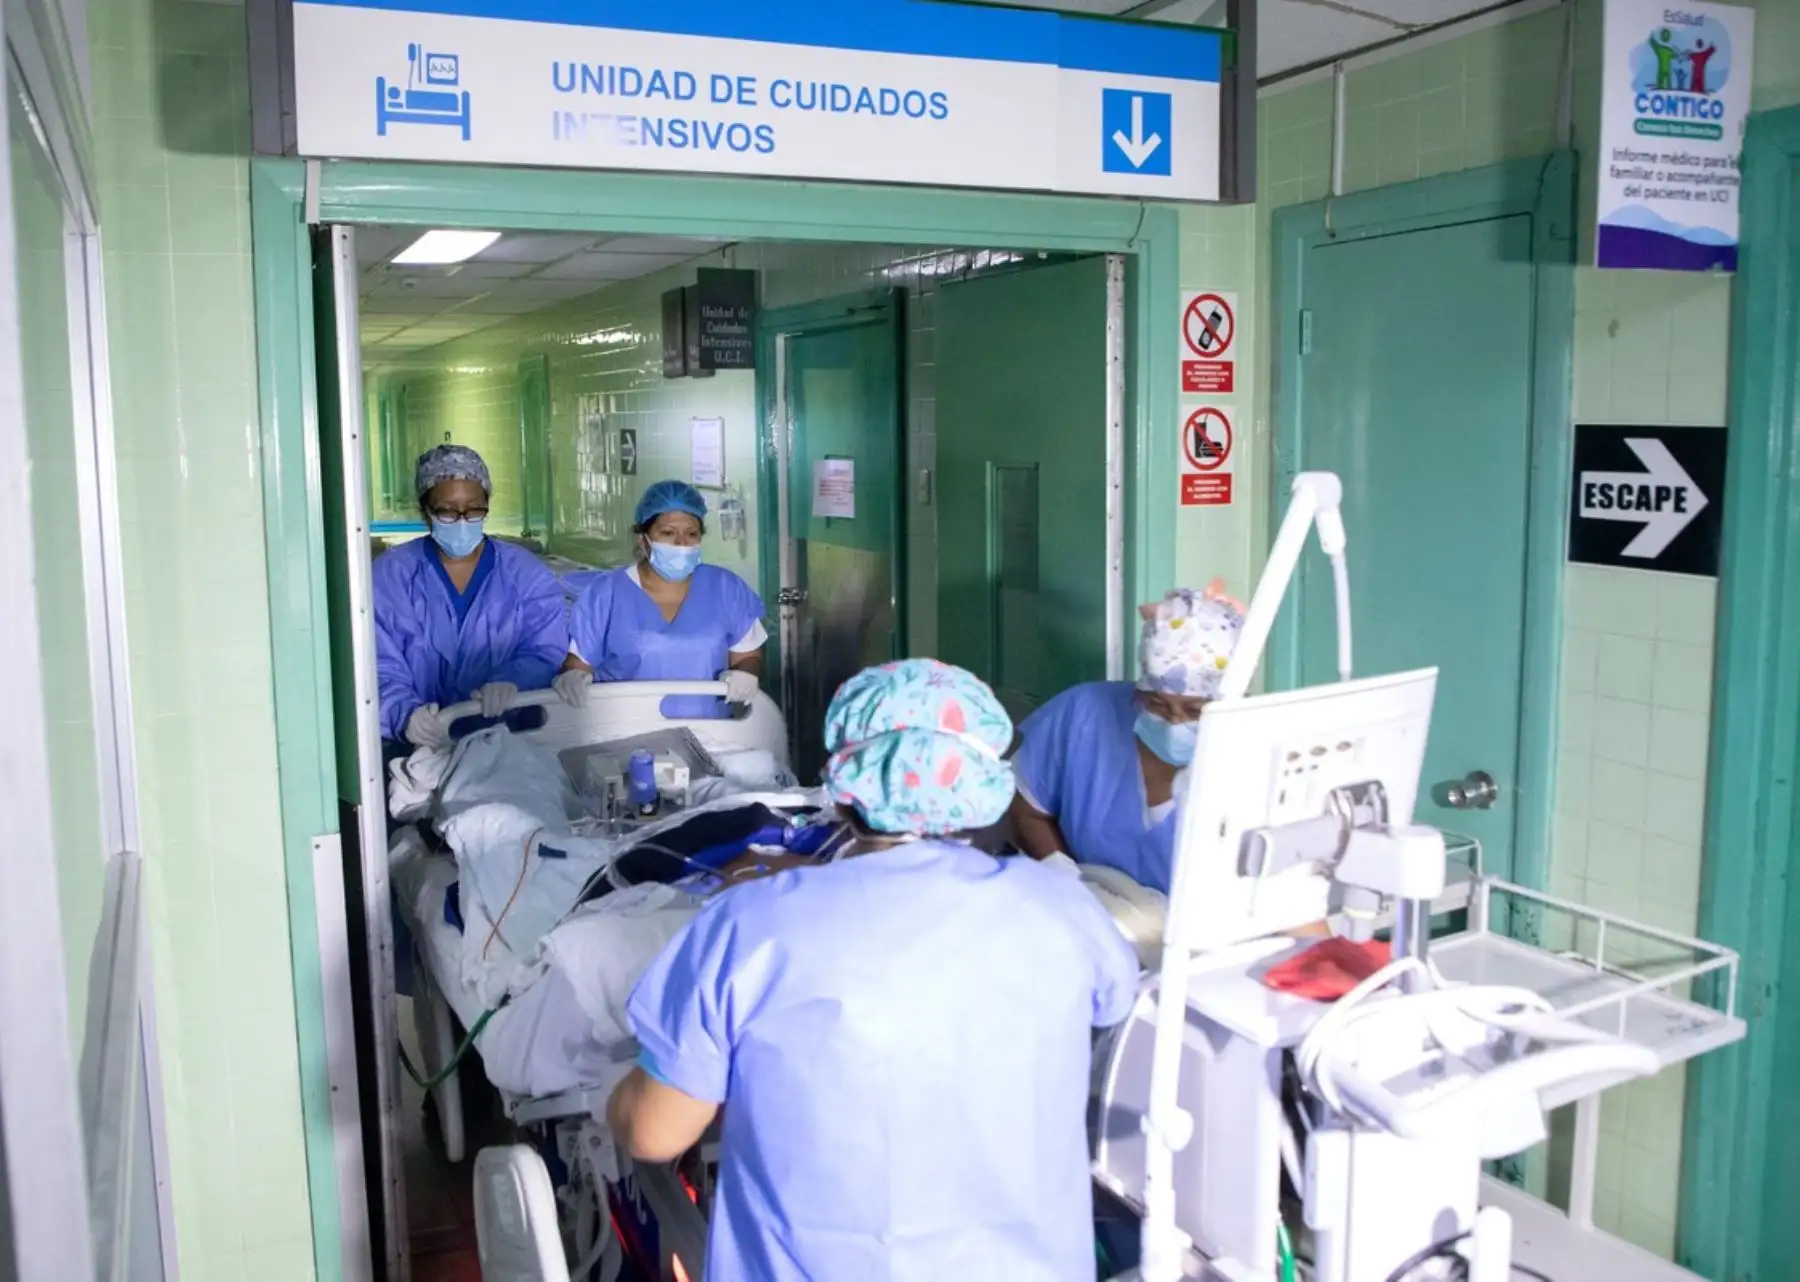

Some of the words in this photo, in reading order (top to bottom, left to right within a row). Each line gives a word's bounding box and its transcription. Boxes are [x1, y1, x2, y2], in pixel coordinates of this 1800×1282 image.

[552, 61, 697, 101] UNIDAD
[710, 74, 757, 106] DE
[769, 79, 949, 120] CUIDADOS
[1635, 93, 1724, 119] CONTIGO
[1613, 147, 1658, 164] Informe
[1703, 156, 1727, 170] para
[1610, 164, 1654, 180] familiar
[1656, 171, 1665, 182] o
[1624, 184, 1642, 198] del
[1644, 187, 1692, 201] paciente
[1694, 191, 1708, 201] en
[1584, 483, 1688, 513] ESCAPE
